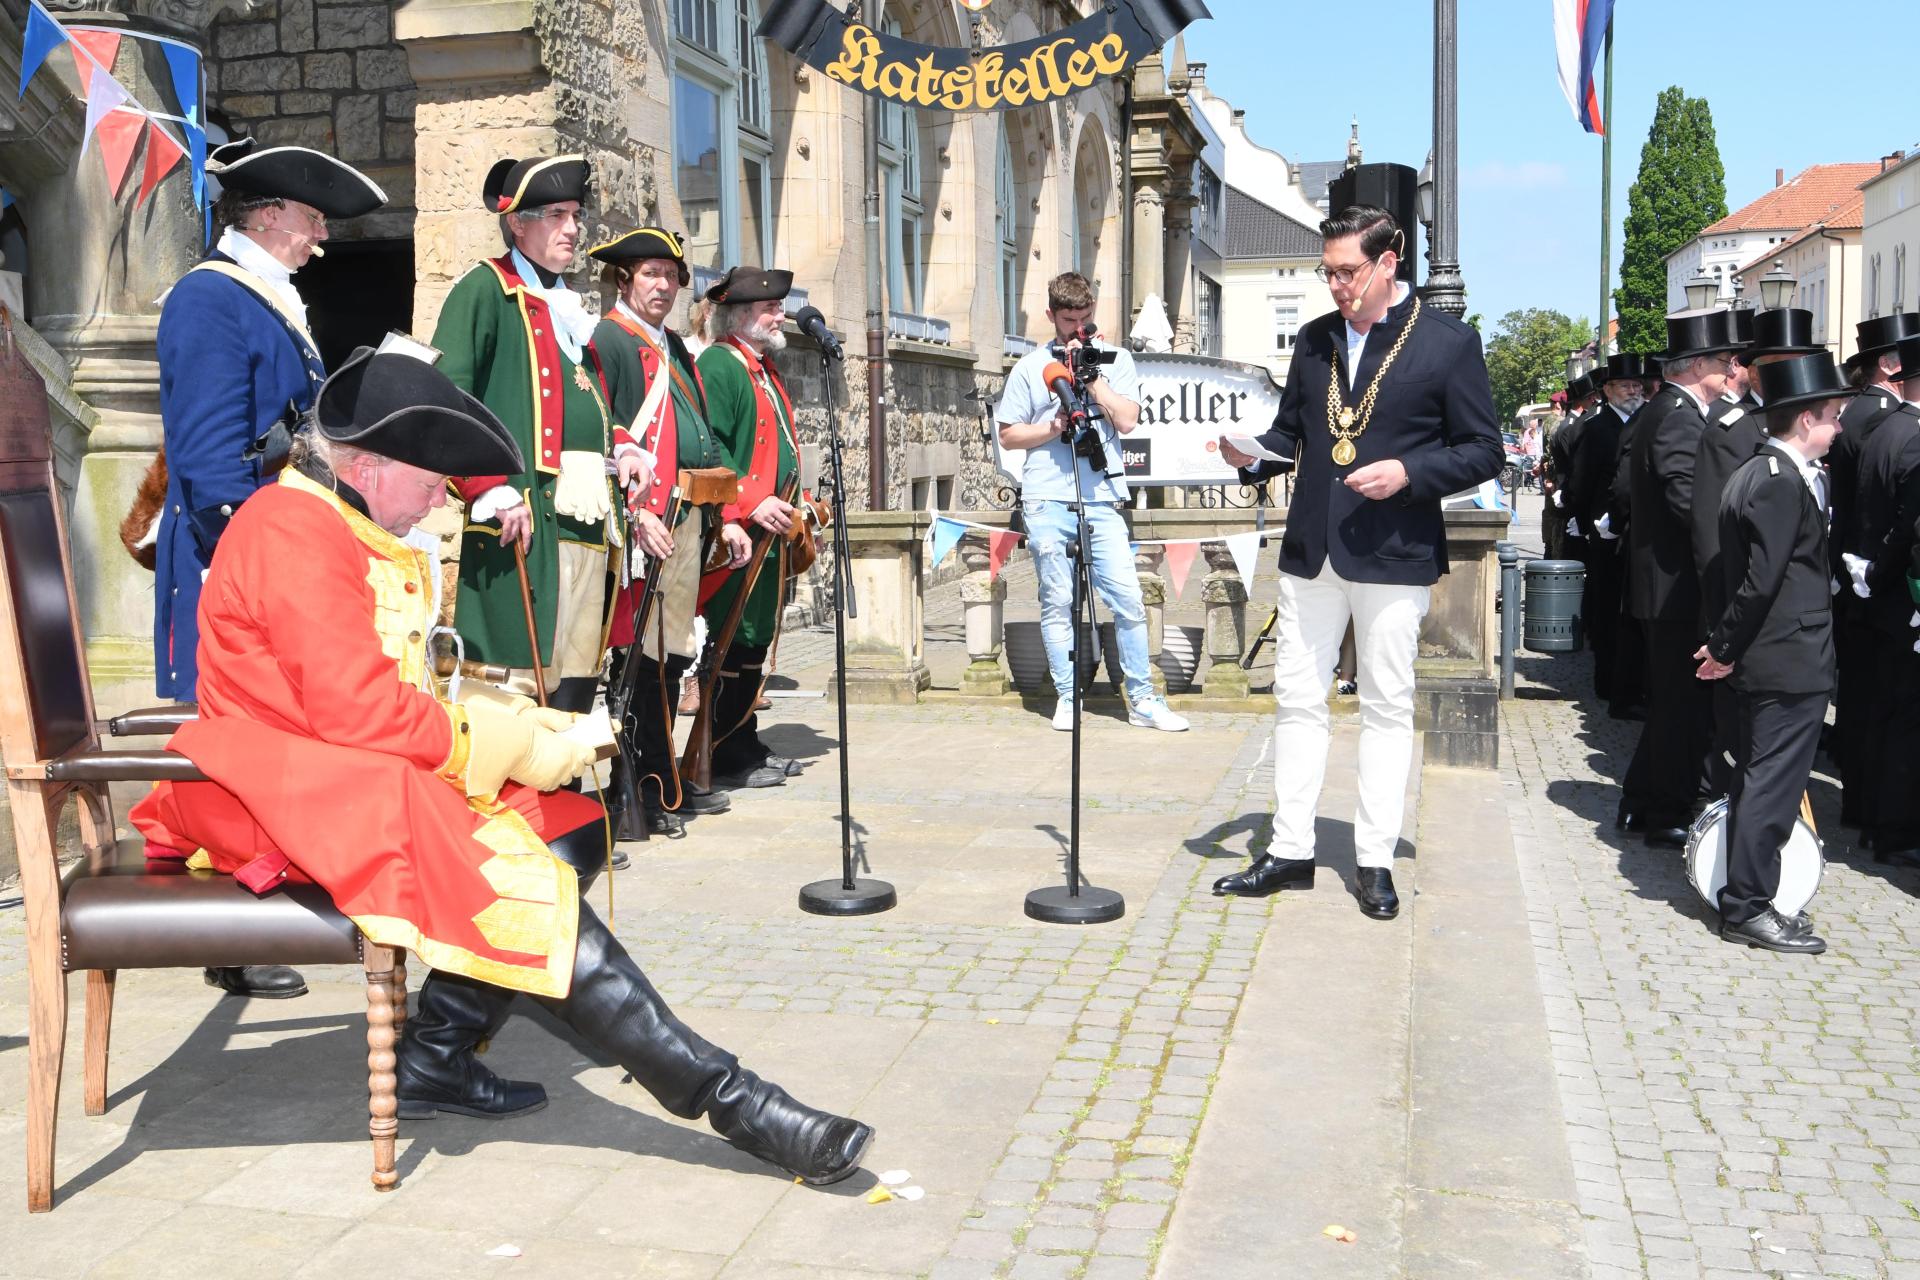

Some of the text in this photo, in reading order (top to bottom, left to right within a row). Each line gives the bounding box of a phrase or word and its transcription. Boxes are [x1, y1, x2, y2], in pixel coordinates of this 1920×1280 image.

[825, 24, 1129, 110] Ratskeller
[1138, 382, 1247, 425] keller
[1122, 450, 1146, 466] itzer
